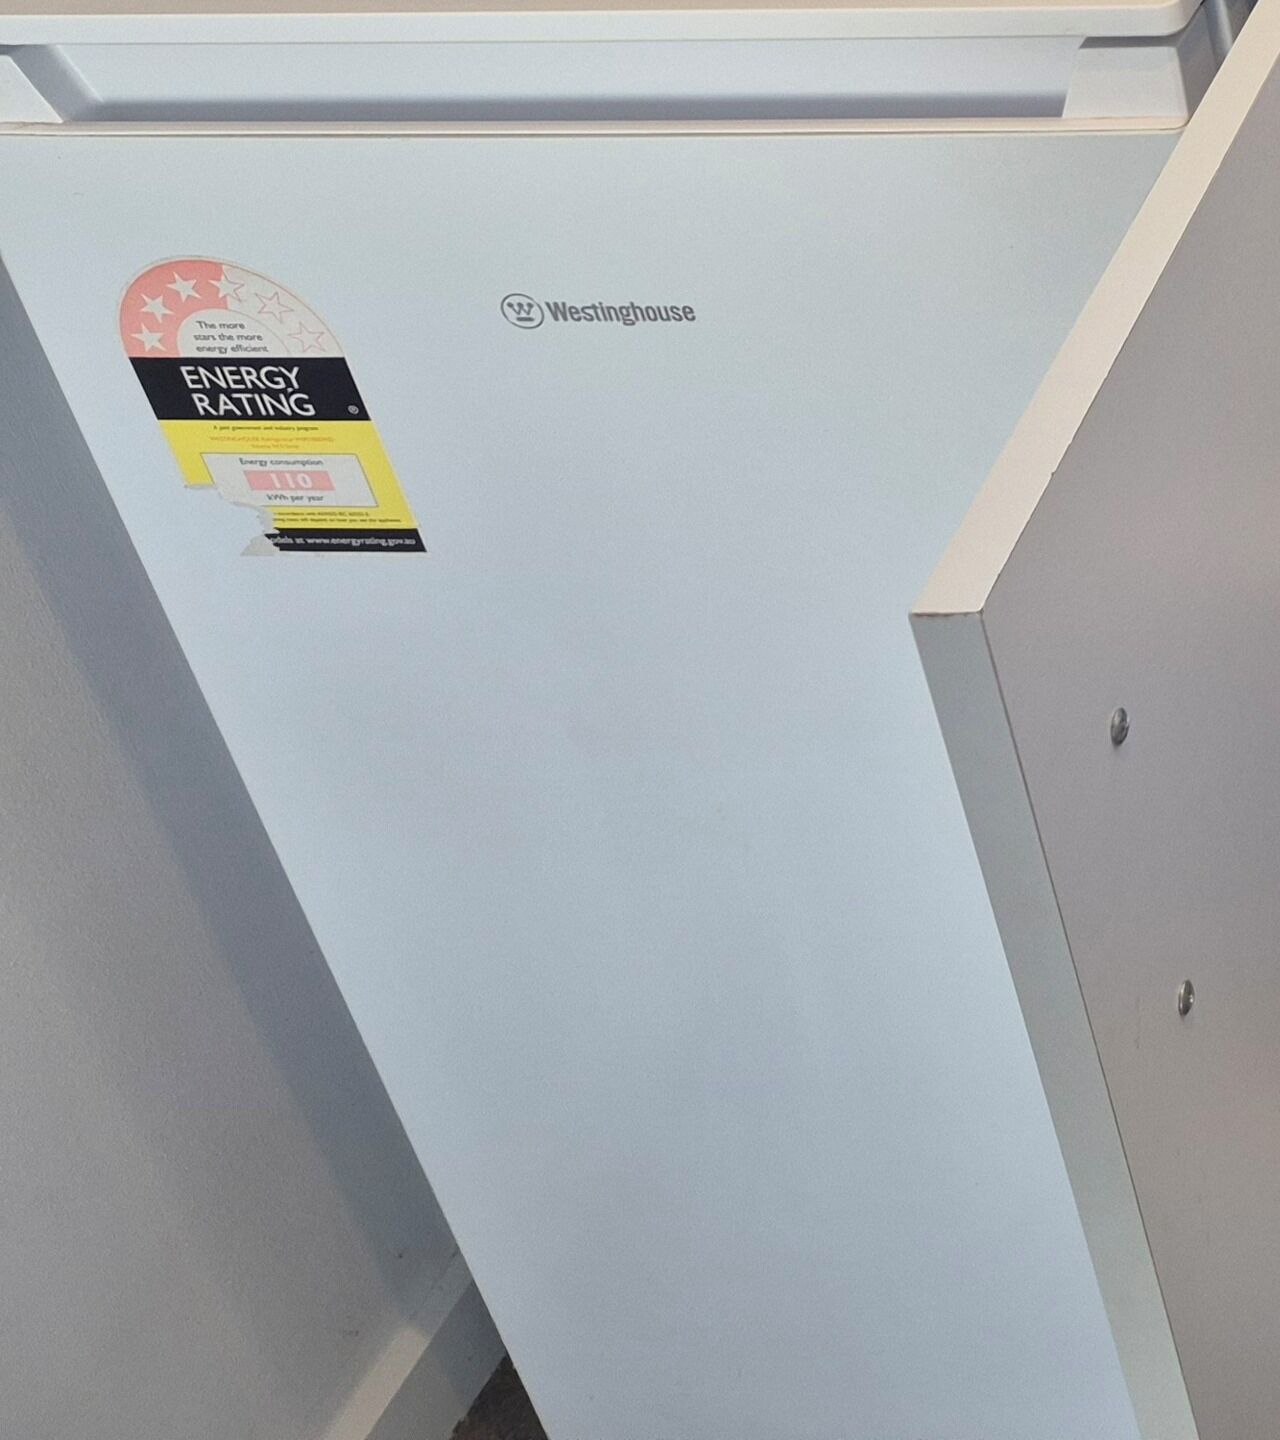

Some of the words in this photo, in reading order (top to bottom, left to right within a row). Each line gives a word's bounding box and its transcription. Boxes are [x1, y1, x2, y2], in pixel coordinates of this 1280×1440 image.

[544, 301, 696, 326] Westinghouse
[195, 320, 216, 329] The
[218, 333, 234, 341] the
[196, 346, 228, 355] energy
[230, 344, 269, 352] efficient
[180, 365, 300, 390] ENERGY
[191, 393, 316, 416] RATING
[238, 457, 268, 467] Energy
[270, 458, 324, 467] consumption
[269, 472, 314, 489] 110
[266, 493, 289, 501] kWh
[290, 495, 305, 503] per
[307, 495, 324, 503] year
